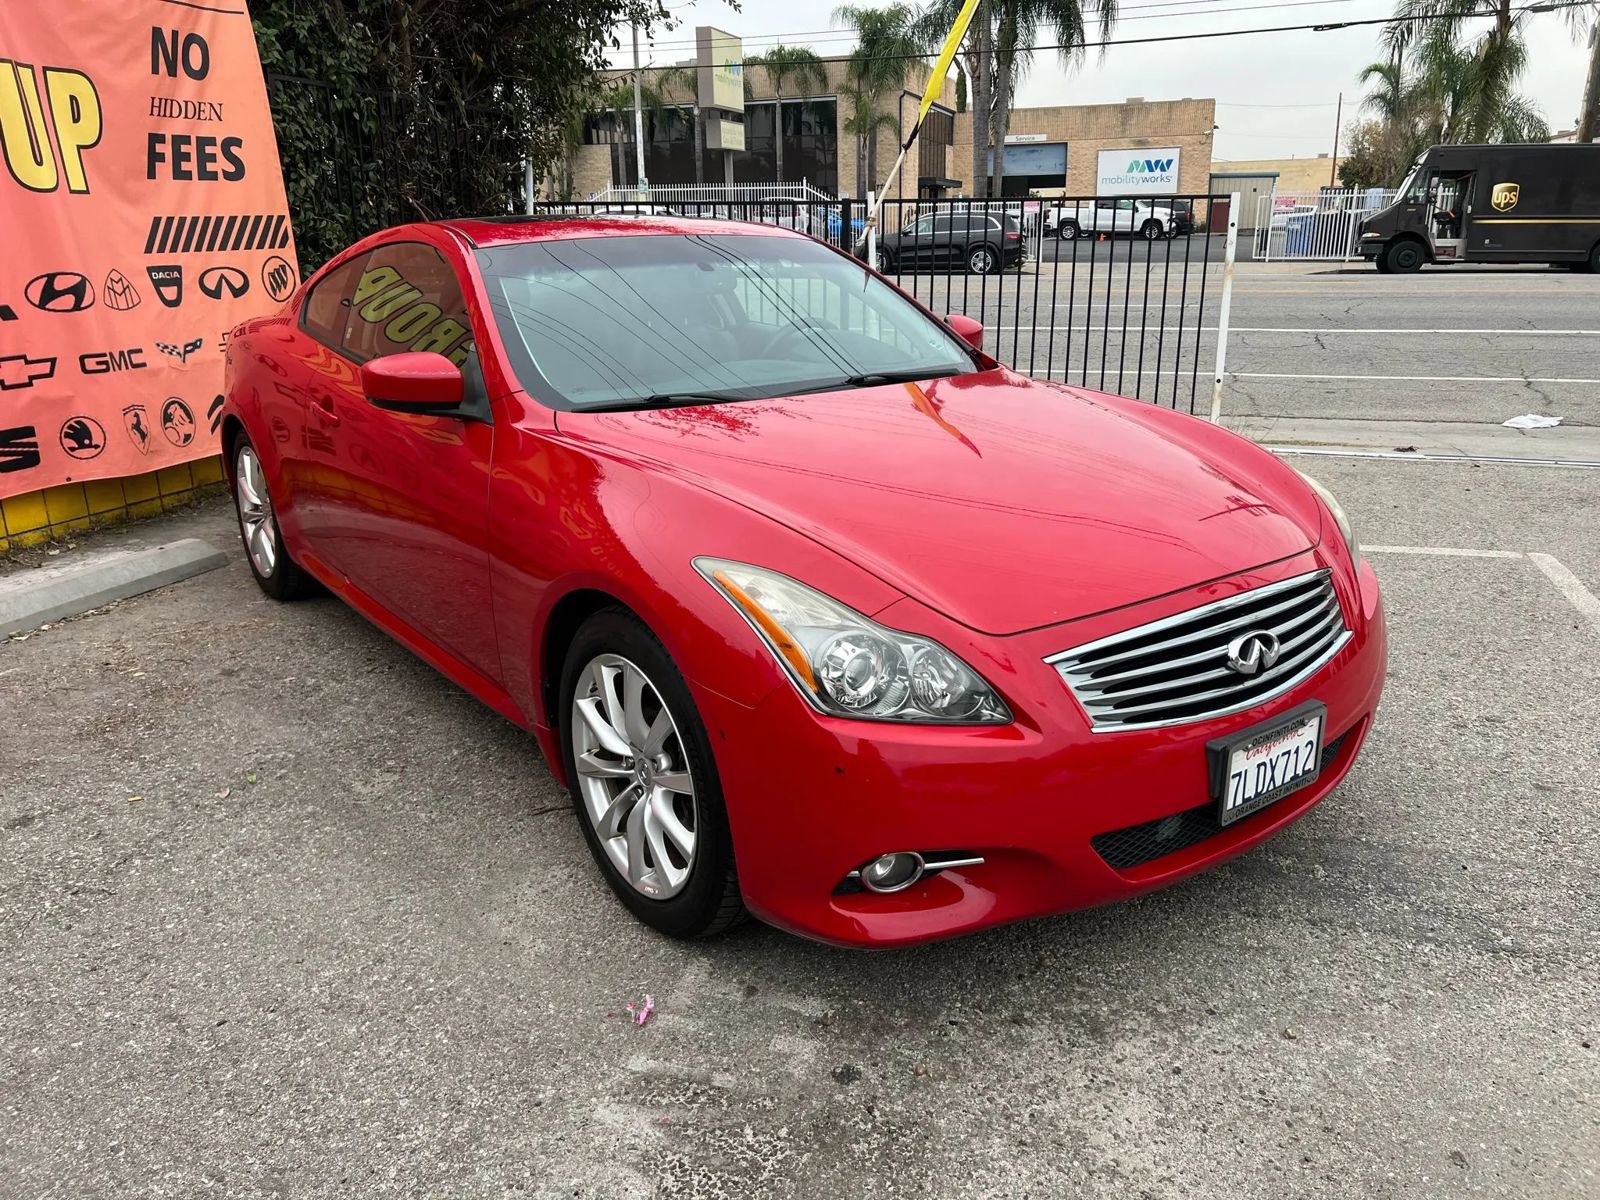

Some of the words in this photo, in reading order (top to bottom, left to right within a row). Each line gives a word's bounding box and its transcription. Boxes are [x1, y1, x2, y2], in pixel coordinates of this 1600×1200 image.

[151, 26, 210, 81] NO
[149, 97, 223, 121] HIDDEN
[146, 132, 246, 181] FEES
[1493, 191, 1517, 208] ups
[151, 271, 181, 280] DACIA
[79, 348, 147, 375] GMC
[1230, 739, 1314, 809] 7LDX712
[1235, 799, 1261, 817] ORANGE
[1261, 789, 1283, 805] COAST
